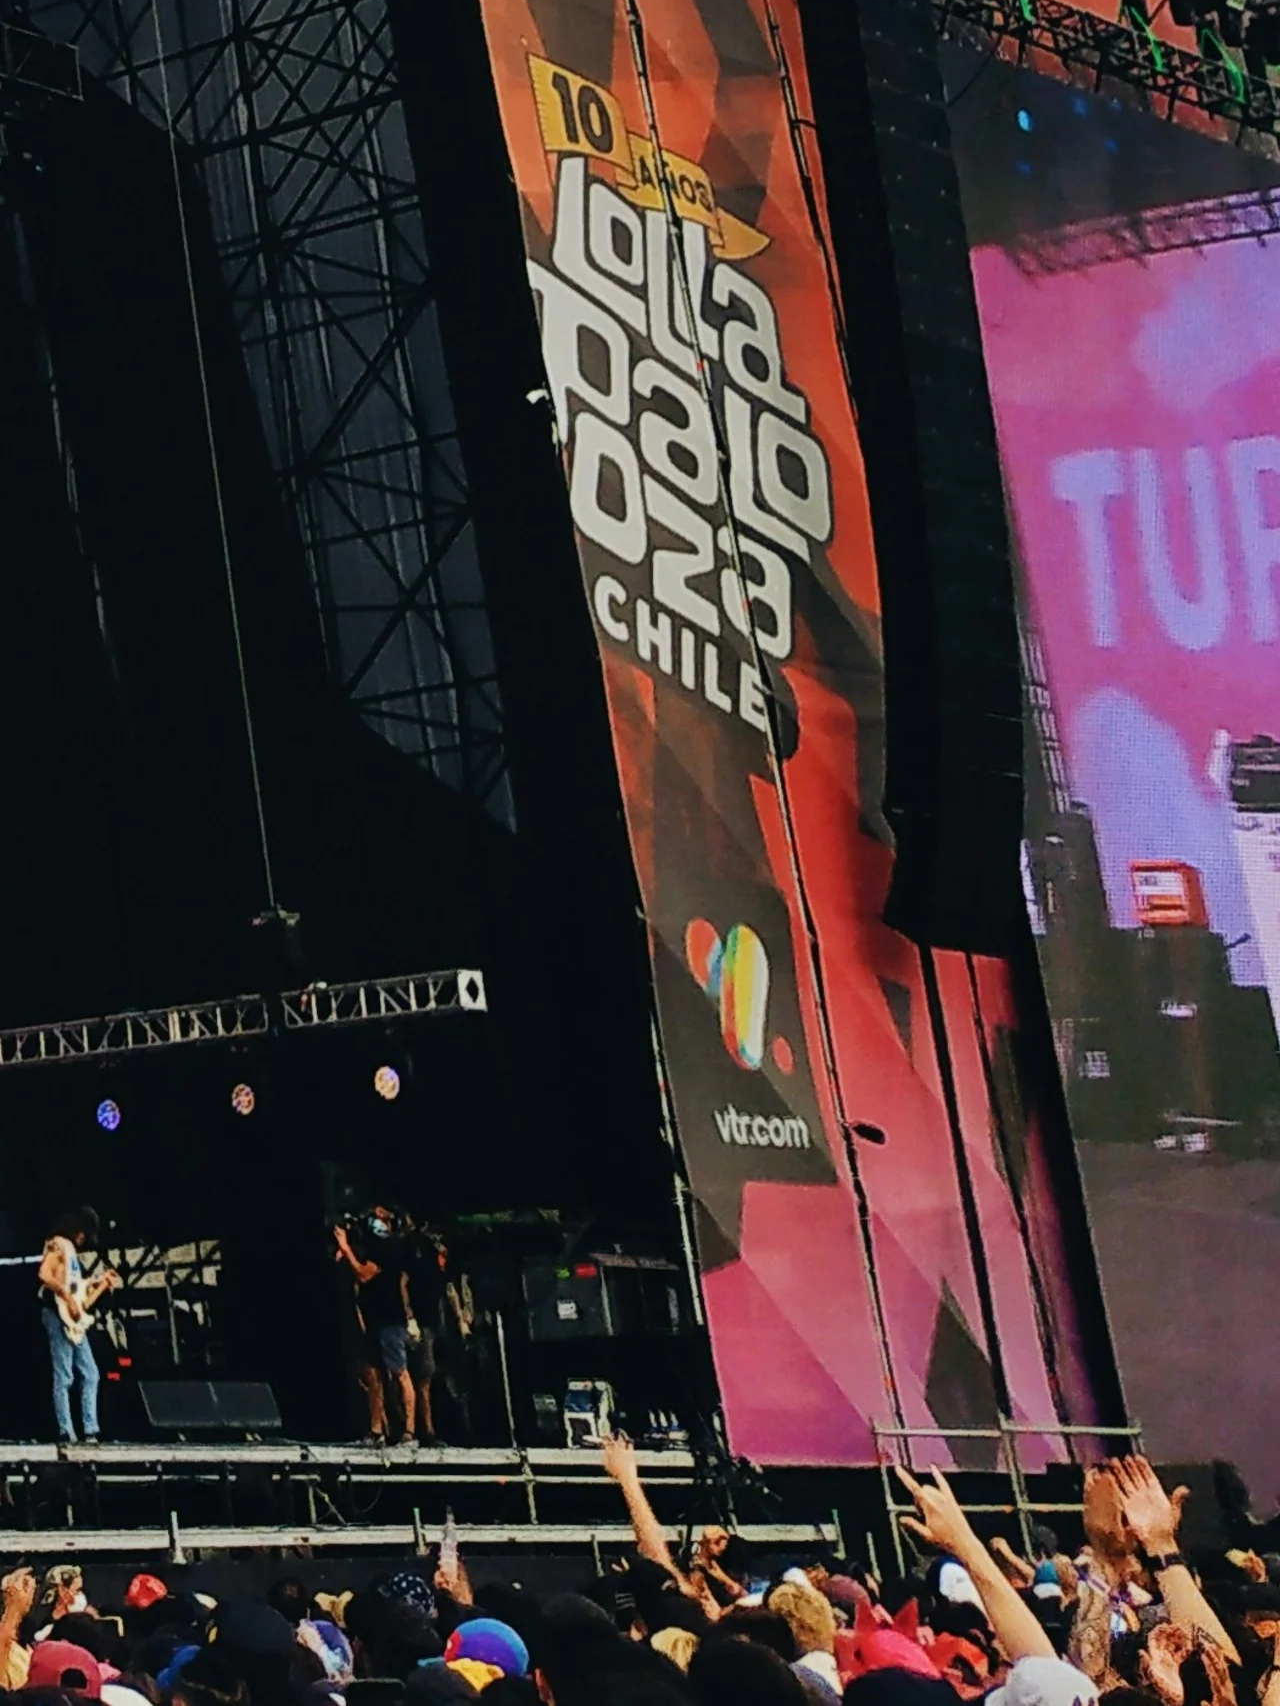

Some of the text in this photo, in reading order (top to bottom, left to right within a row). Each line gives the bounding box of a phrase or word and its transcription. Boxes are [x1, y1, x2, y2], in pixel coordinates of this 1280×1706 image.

[552, 71, 614, 155] 10
[593, 575, 770, 734] CHILE
[714, 1103, 811, 1149] vtr.com
